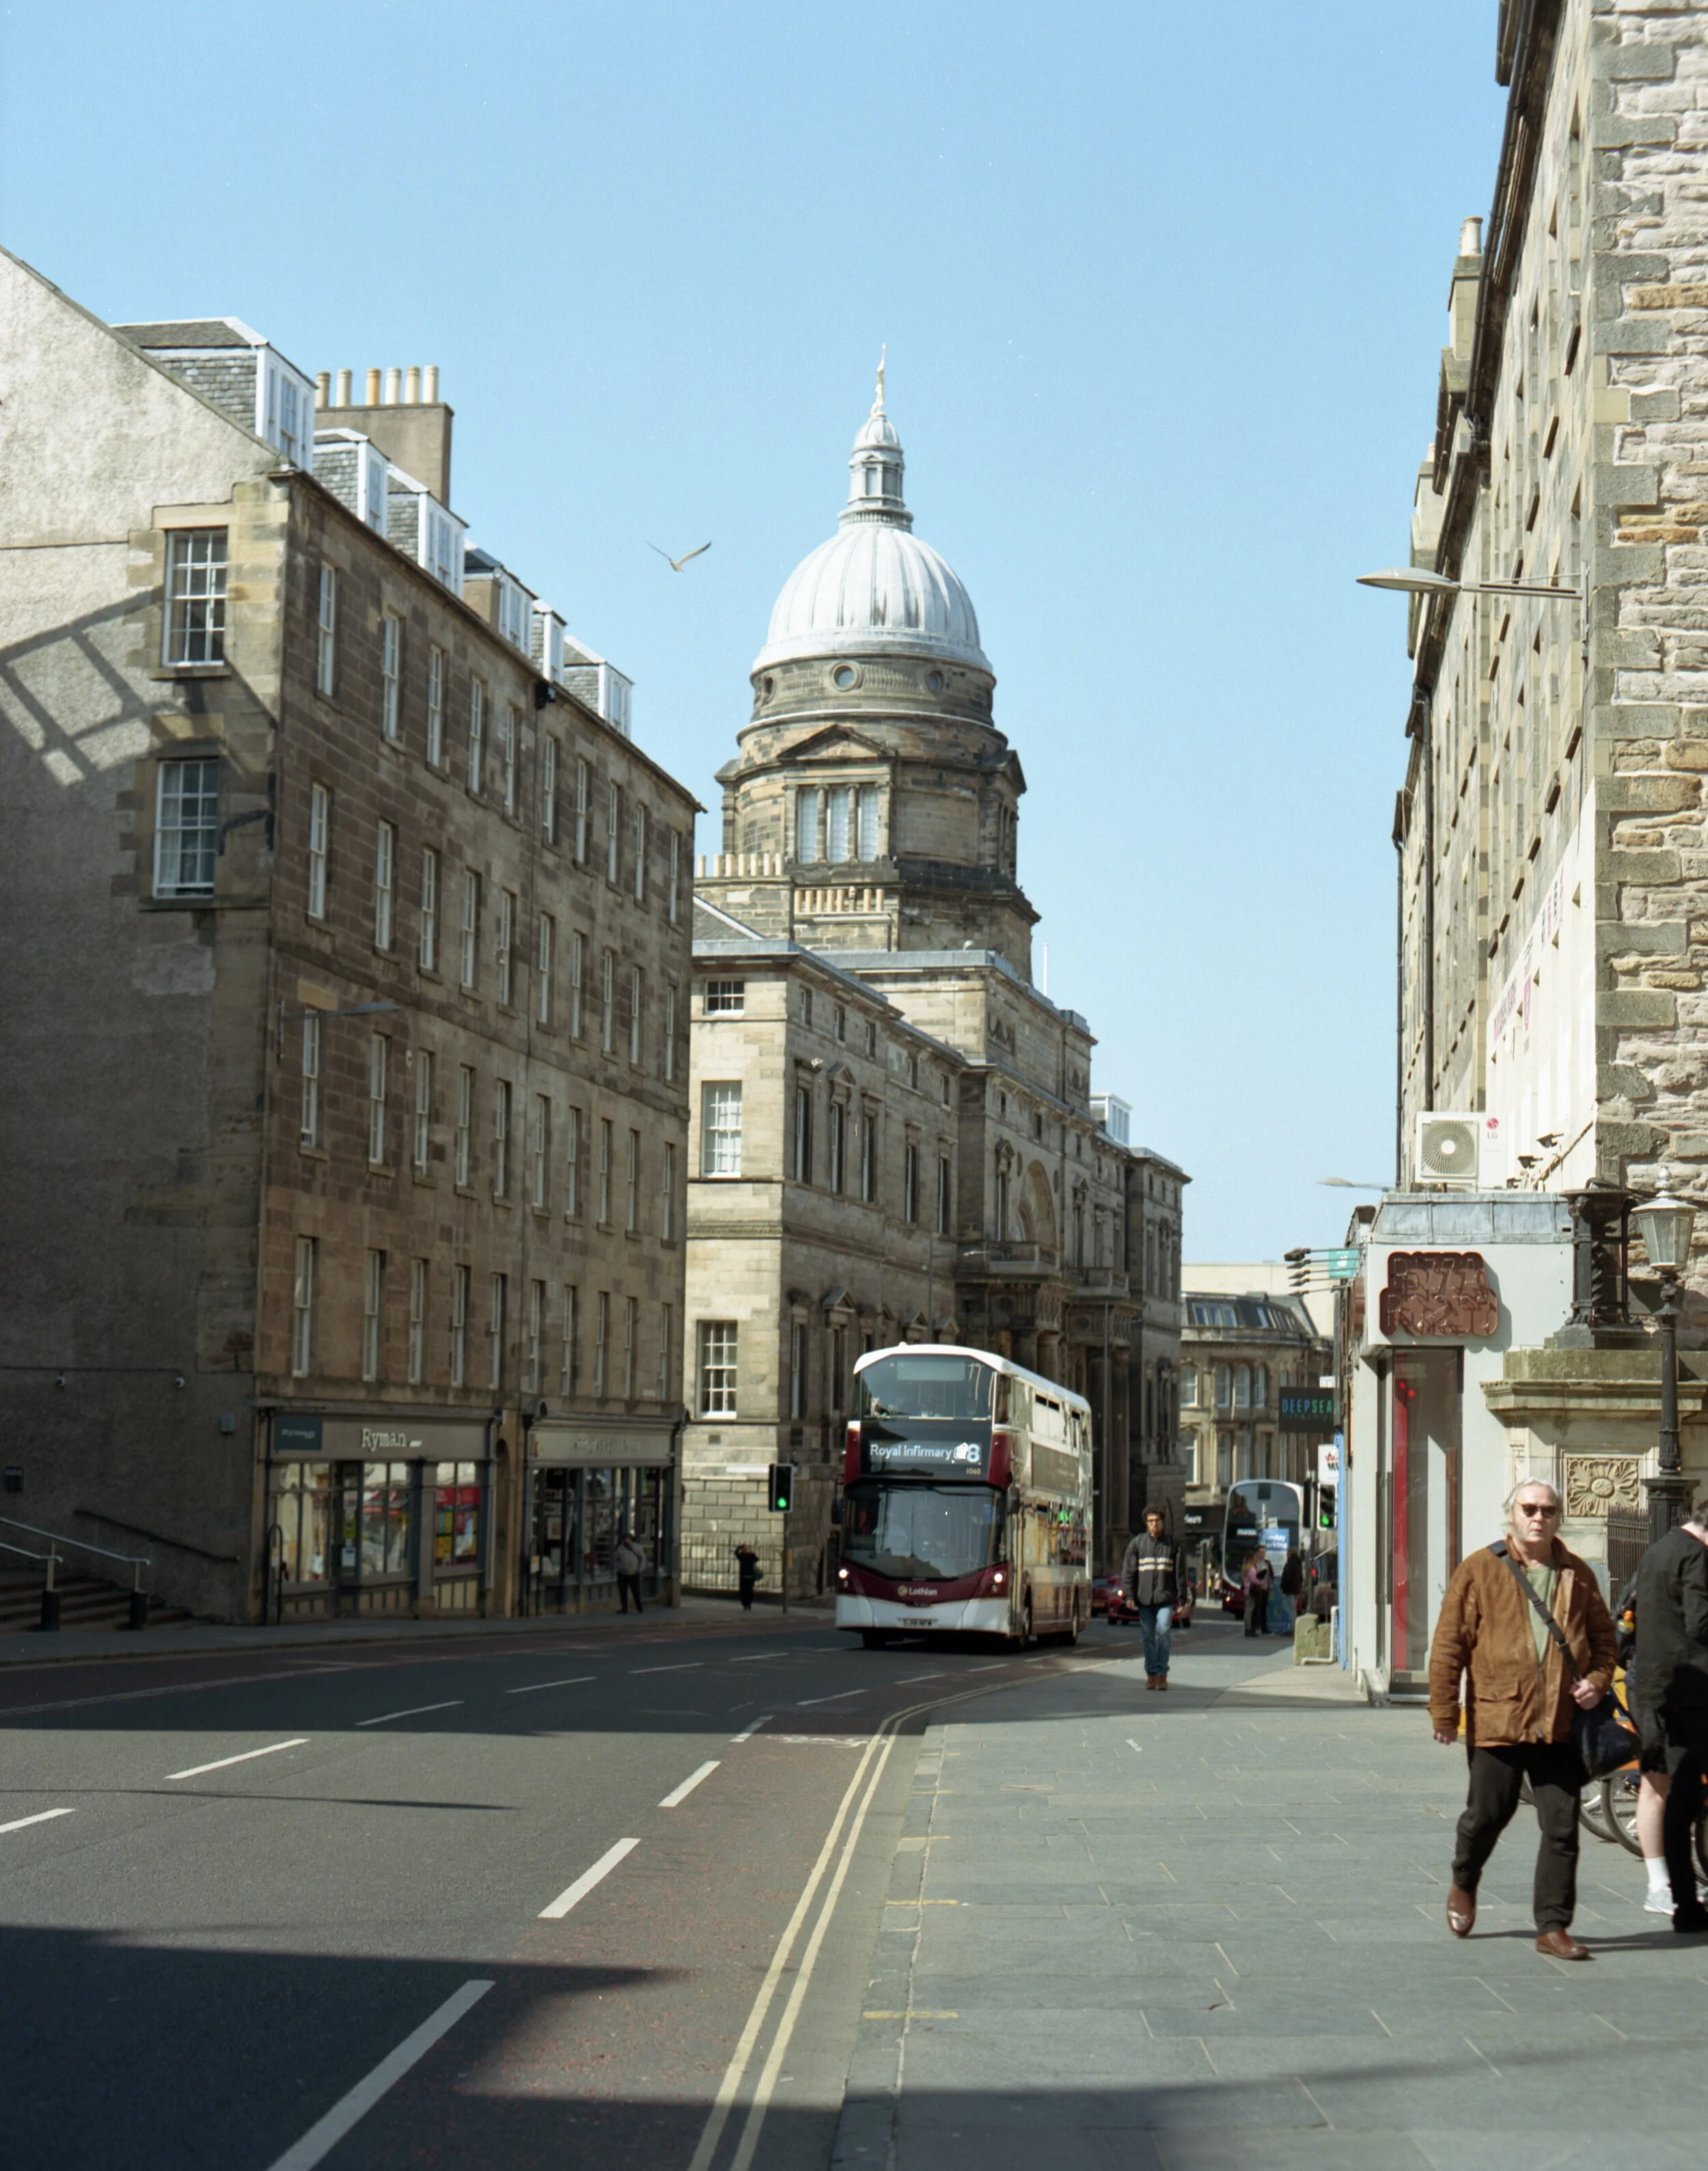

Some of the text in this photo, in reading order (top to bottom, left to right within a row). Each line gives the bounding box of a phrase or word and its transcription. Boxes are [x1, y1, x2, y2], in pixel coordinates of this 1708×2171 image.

[1391, 1256, 1480, 1290] PIZZA
[361, 1428, 407, 1452] Ryman
[870, 1444, 901, 1459] Royal
[904, 1445, 952, 1461] Infirmary
[909, 1586, 937, 1596] Lothian
